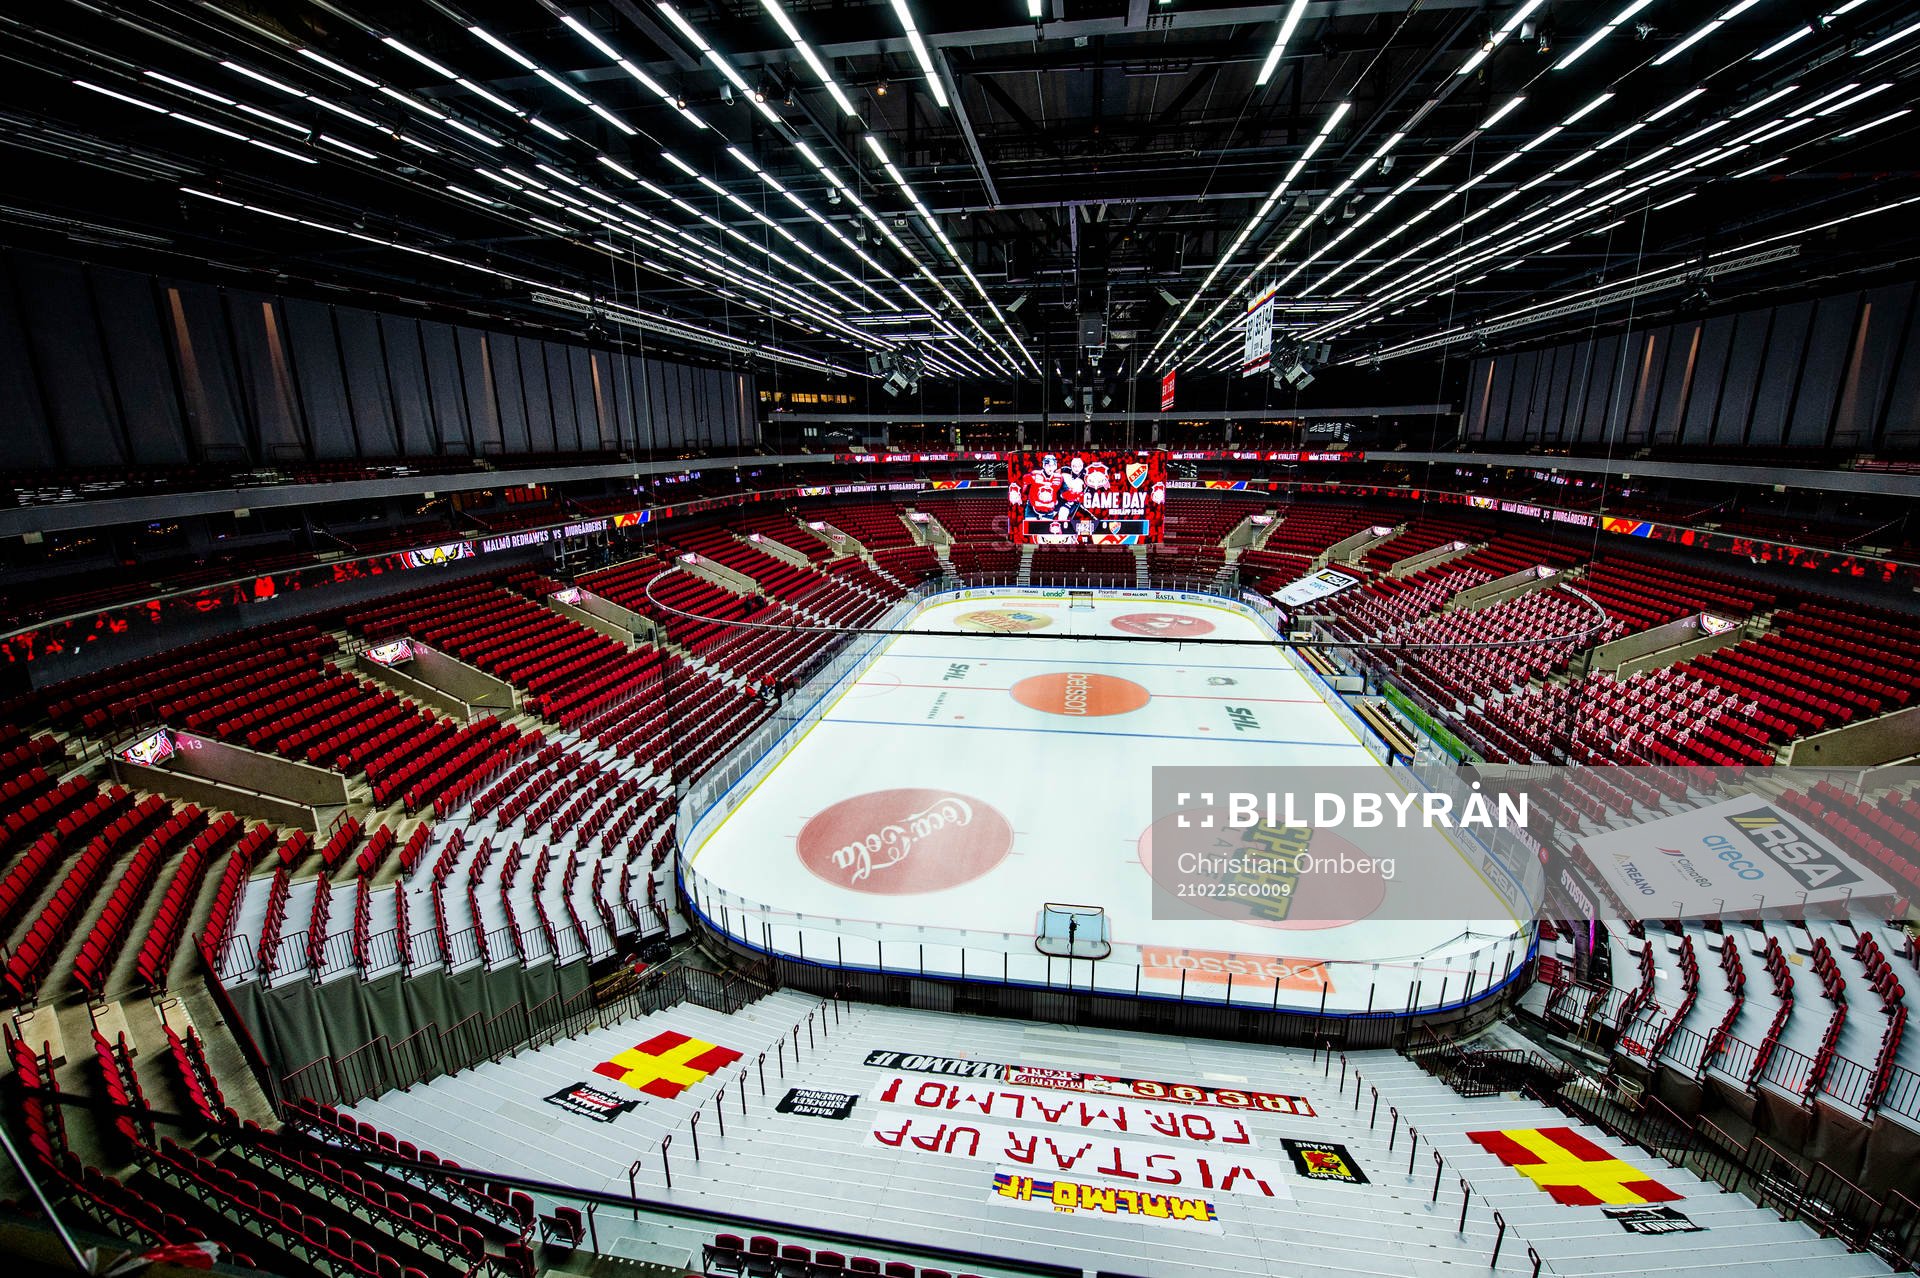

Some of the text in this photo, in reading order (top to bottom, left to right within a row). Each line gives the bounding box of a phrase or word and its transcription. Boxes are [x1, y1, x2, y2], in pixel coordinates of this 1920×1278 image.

[1084, 492, 1147, 509] GAME DAY
[483, 537, 510, 552] MALMÖ
[512, 531, 549, 548] REDHAWKS
[565, 520, 601, 537] DJURGÅRDENS
[1064, 673, 1088, 715] betsson
[187, 739, 202, 750] 13
[832, 798, 972, 884] Coca-Cola
[1702, 834, 1764, 881] areco
[1750, 824, 1842, 886] RSA
[1621, 862, 1656, 896] TREANO
[1150, 950, 1324, 986] betsson
[870, 1050, 898, 1066] IF
[873, 1120, 980, 1157] UPP
[997, 1175, 1209, 1222] MALMÖ IF
